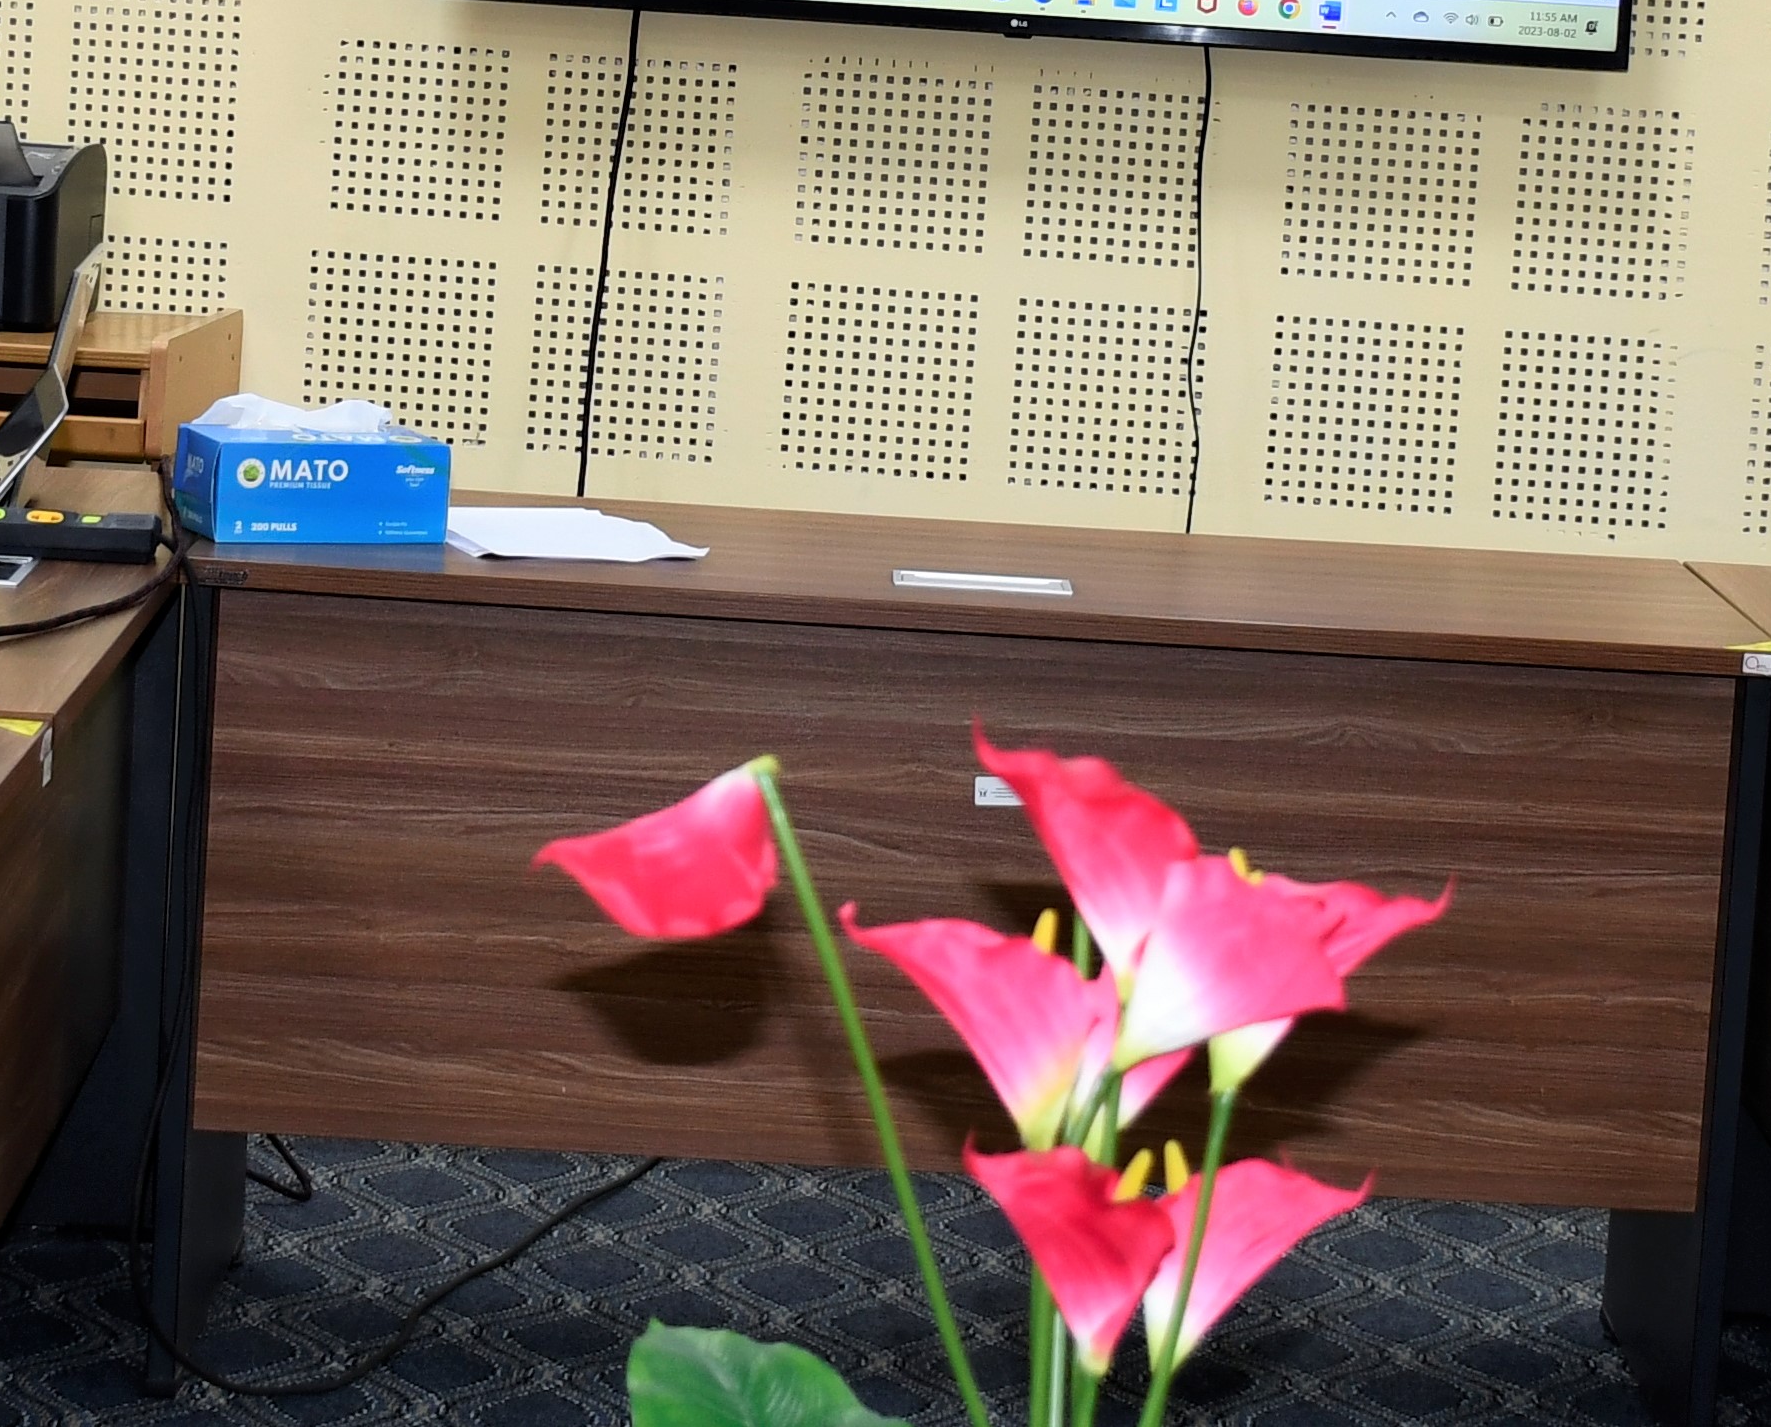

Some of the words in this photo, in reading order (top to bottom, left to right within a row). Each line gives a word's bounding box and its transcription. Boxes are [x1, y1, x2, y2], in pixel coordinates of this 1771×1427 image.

[1529, 11, 1557, 22] 11:55
[1559, 12, 1578, 23] AM
[1517, 25, 1577, 39] 2023-08-02
[270, 459, 349, 481] MATO
[269, 481, 304, 489] PREMIUM
[305, 481, 331, 489] TISSUE
[270, 522, 297, 532] PULLS
